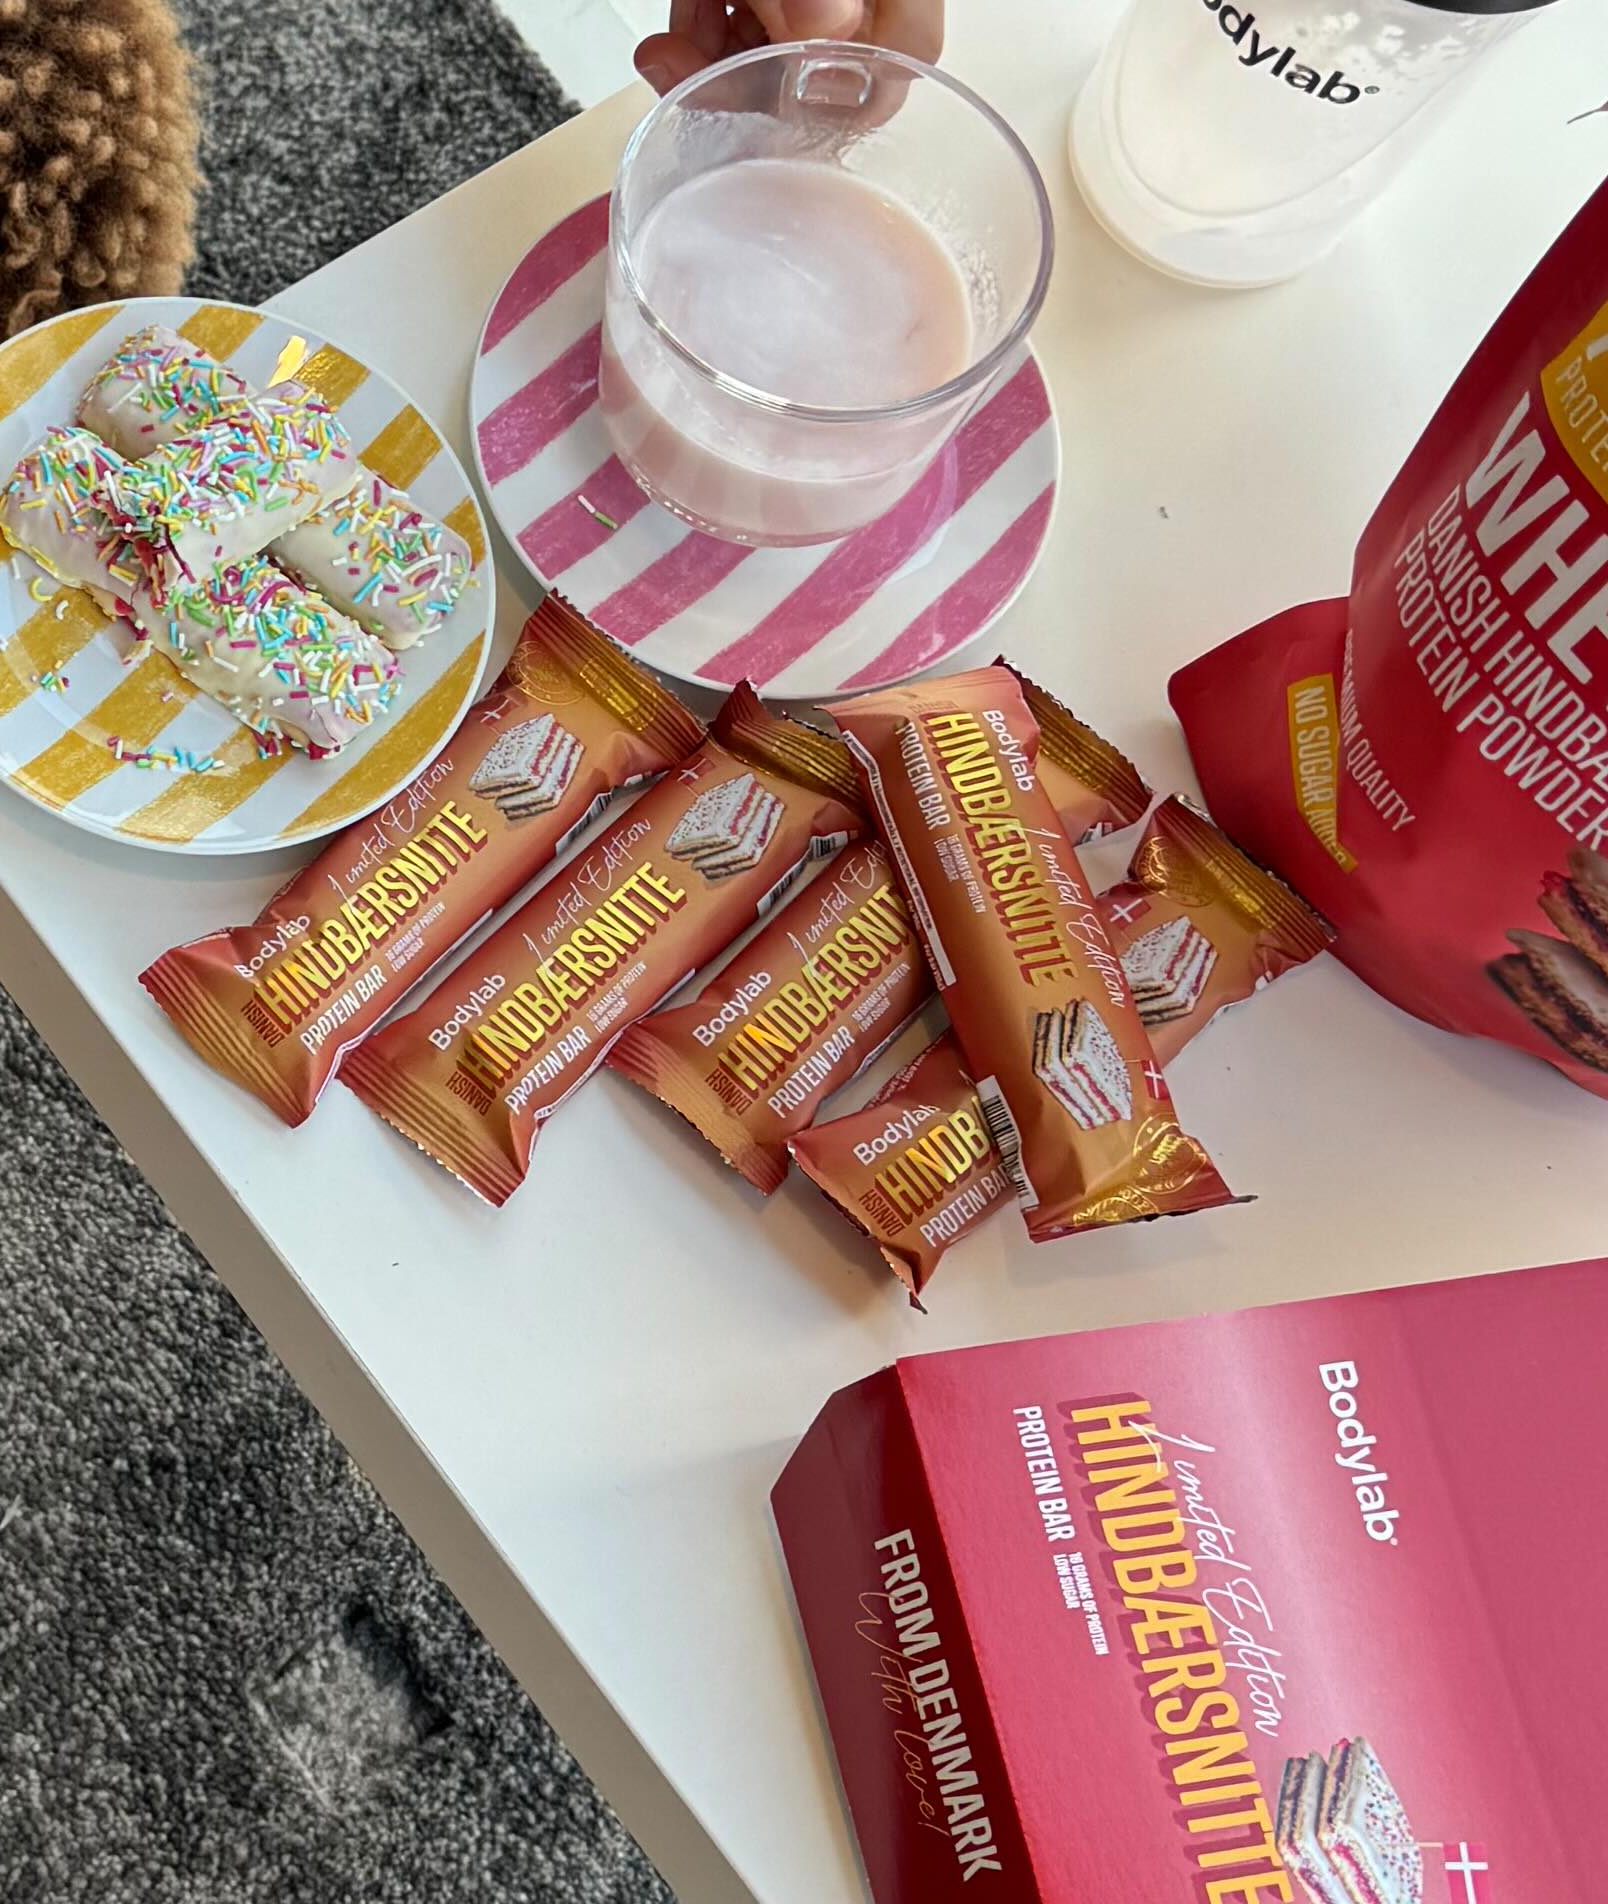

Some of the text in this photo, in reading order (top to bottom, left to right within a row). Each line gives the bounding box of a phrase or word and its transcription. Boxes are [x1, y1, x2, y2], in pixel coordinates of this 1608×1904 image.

[1428, 483, 1510, 653] DANISH
[1395, 529, 1480, 712] PROTEIN
[1294, 685, 1329, 724] NO
[896, 722, 941, 801] PROTEIN
[982, 710, 1035, 792] Bodylab
[1296, 726, 1334, 806] SUGAR
[1346, 739, 1416, 831] QUALITY
[381, 758, 454, 833] Edition
[918, 793, 952, 831] BAR
[577, 818, 652, 892] Edition
[926, 712, 1079, 987] HINDBÆRSNITTE
[235, 914, 310, 978] Bodylab
[254, 801, 487, 1025] HINDBÆRSNITTE
[299, 965, 388, 1055] PROTEIN BAR
[428, 973, 507, 1051] Bodylab
[456, 862, 686, 1089] HINDBÆRSNITTE
[692, 970, 772, 1047] Bodylab
[242, 1000, 286, 1046] DANISH
[446, 1071, 493, 1116] DANISH
[503, 1026, 592, 1116] PROTEIN BAR
[704, 1068, 752, 1116] DANISH
[767, 1050, 833, 1119] PROTEIN
[824, 1026, 856, 1064] BAR
[875, 1096, 990, 1220] HINDB
[858, 1189, 906, 1237] DANISH
[919, 1188, 987, 1247] PROTEIN
[1013, 1405, 1075, 1542] PROTEIN BAR
[1054, 1553, 1080, 1609] LOW SUGAR
[1073, 1564, 1094, 1601] GRAMS
[1082, 1600, 1098, 1613] OF
[1128, 1420, 1286, 1737] Limited Edition
[1086, 1614, 1109, 1655] PROTEIN
[874, 1529, 1002, 1882] FROM DENMARK
